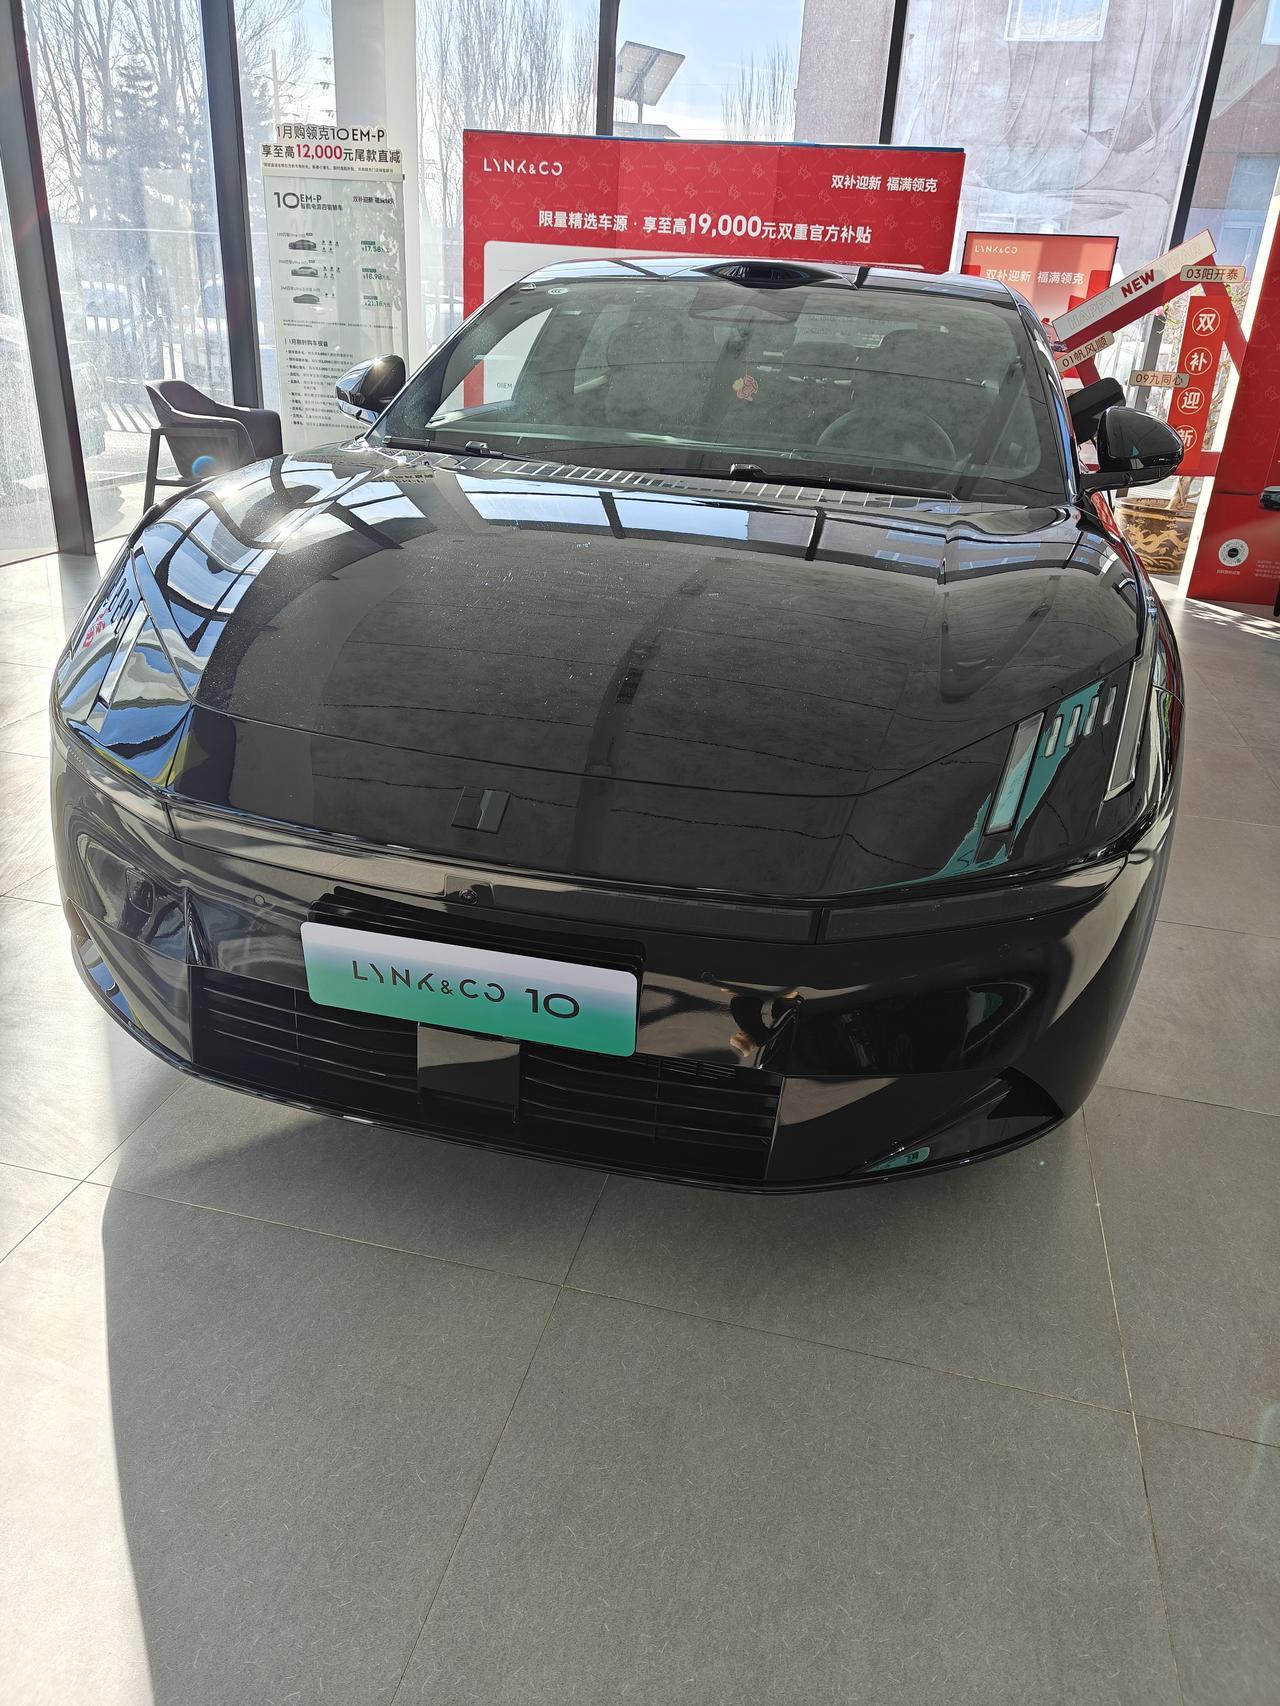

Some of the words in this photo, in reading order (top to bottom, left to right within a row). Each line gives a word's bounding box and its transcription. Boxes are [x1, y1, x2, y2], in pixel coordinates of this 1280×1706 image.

[277, 126, 385, 142] 1月购领克10EM-P
[262, 144, 401, 164] 享至高12,000元尾款直减
[483, 158, 563, 176] LYNK&CO
[831, 175, 882, 191] 双补迎新
[887, 177, 939, 193] 福满领克
[986, 269, 1032, 283] 双补迎新
[1037, 271, 1085, 285] 福满领克
[1186, 268, 1239, 281] 03阳开泰
[1067, 292, 1114, 330] HAPPY
[1120, 269, 1155, 298] NEW
[1062, 336, 1107, 368] 01帆风顺
[1136, 374, 1183, 386] 09九同心
[352, 960, 505, 1002] LYNK&CO
[525, 988, 580, 1019] 10
